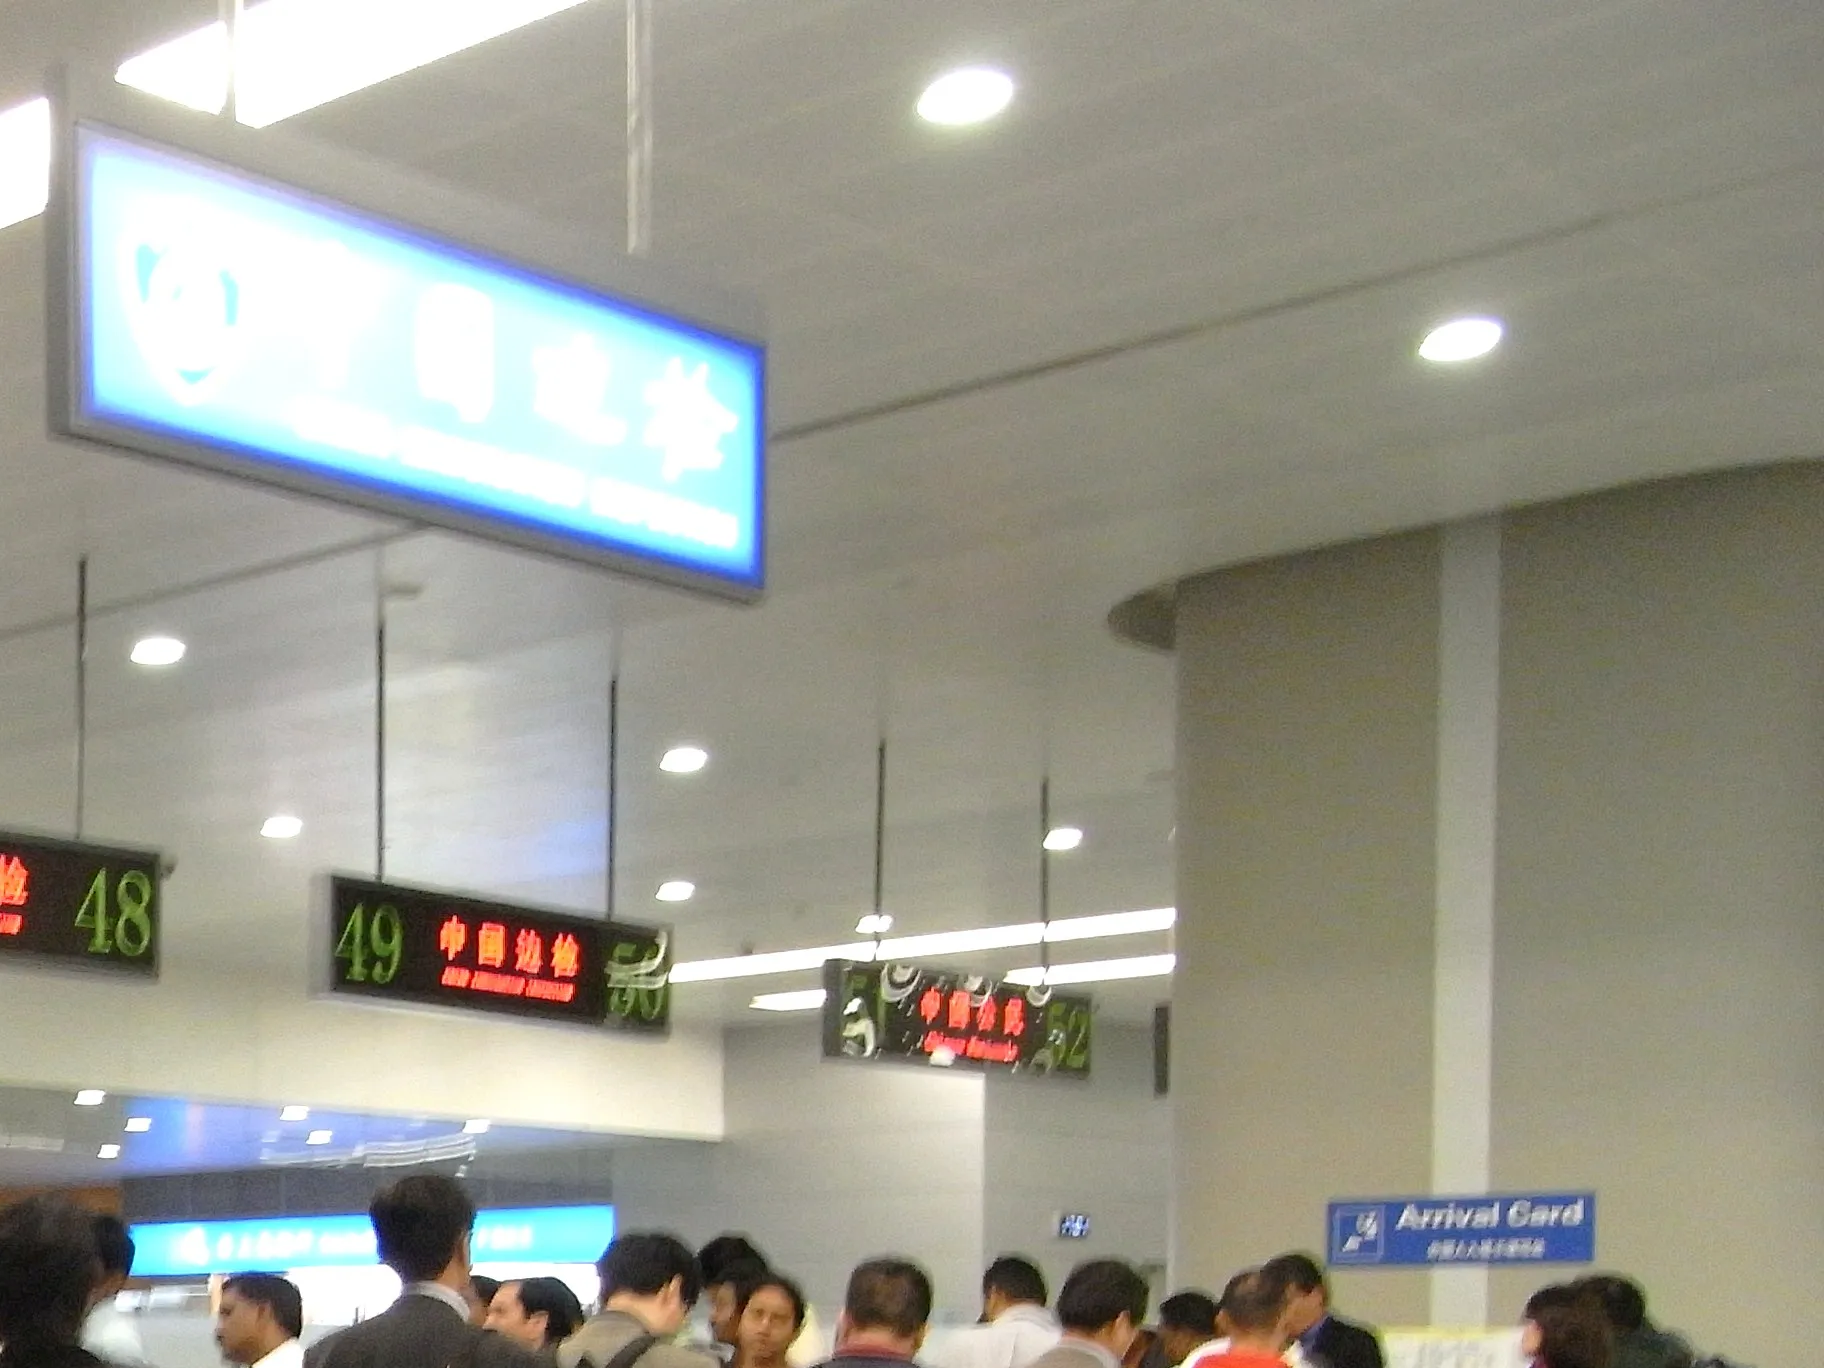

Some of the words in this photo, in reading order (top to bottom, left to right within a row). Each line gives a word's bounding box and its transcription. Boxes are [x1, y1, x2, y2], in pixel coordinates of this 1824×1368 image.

[74, 866, 152, 956] 48
[334, 902, 403, 984] 49
[1395, 1202, 1500, 1231] Arrival
[1507, 1199, 1584, 1227] Card
